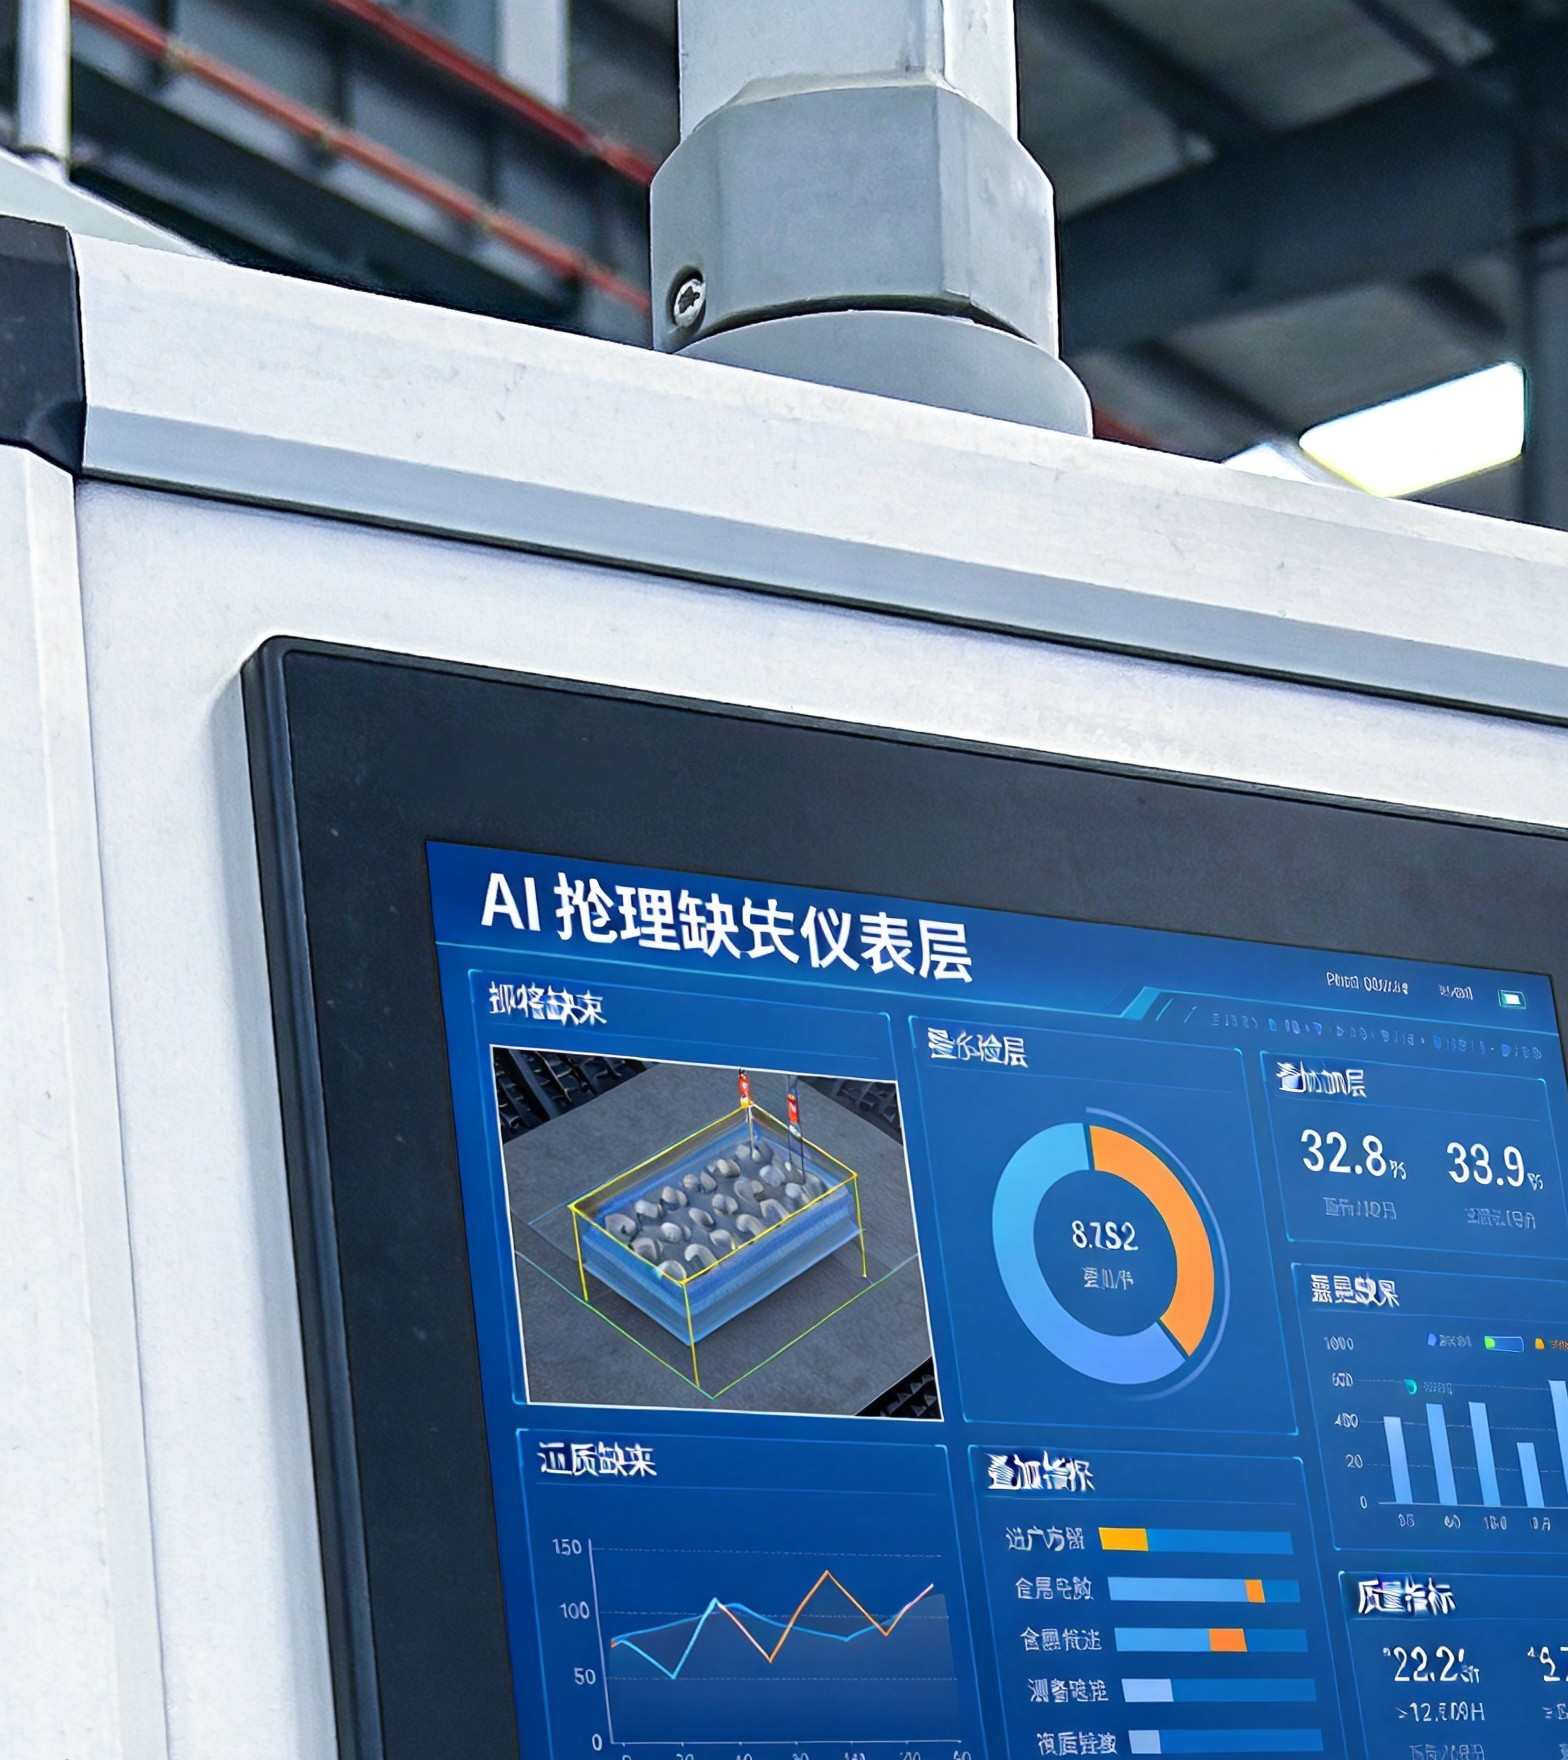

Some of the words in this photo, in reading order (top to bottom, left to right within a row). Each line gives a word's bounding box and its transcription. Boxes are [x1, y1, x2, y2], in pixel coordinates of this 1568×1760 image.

[481, 872, 541, 932] AI
[552, 1538, 582, 1556] 150
[559, 1601, 590, 1620] 100
[573, 1667, 596, 1686] 50
[591, 1733, 603, 1752] 0
